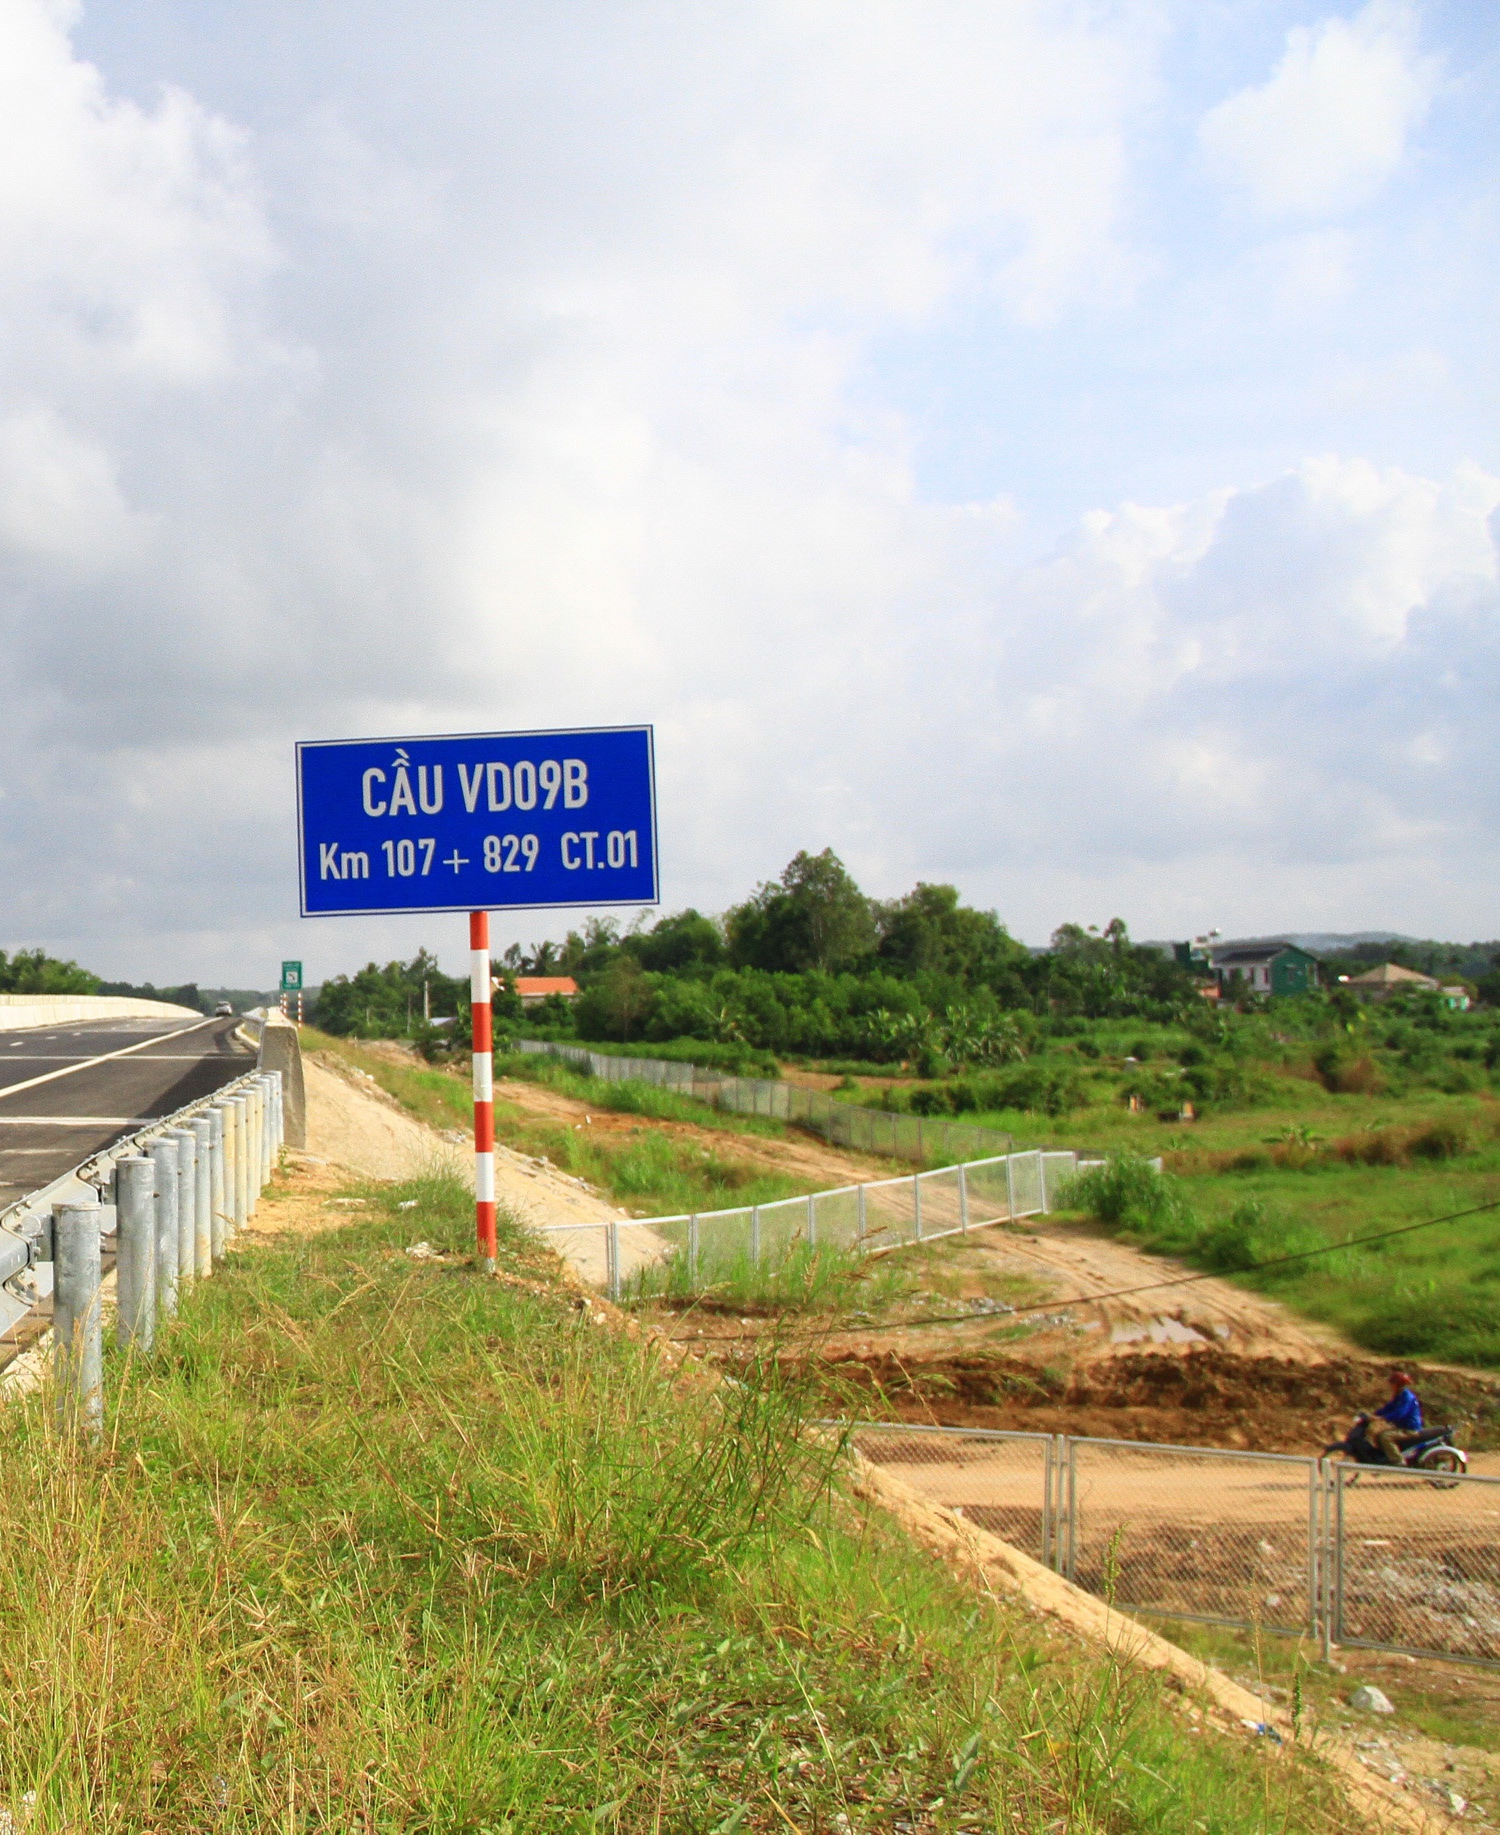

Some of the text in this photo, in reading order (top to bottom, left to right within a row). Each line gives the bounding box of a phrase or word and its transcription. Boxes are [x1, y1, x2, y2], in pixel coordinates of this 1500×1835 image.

[362, 748, 589, 817] CẦU VD09B
[319, 842, 370, 881] Km
[483, 833, 540, 873] 829
[560, 829, 638, 870] CT.01
